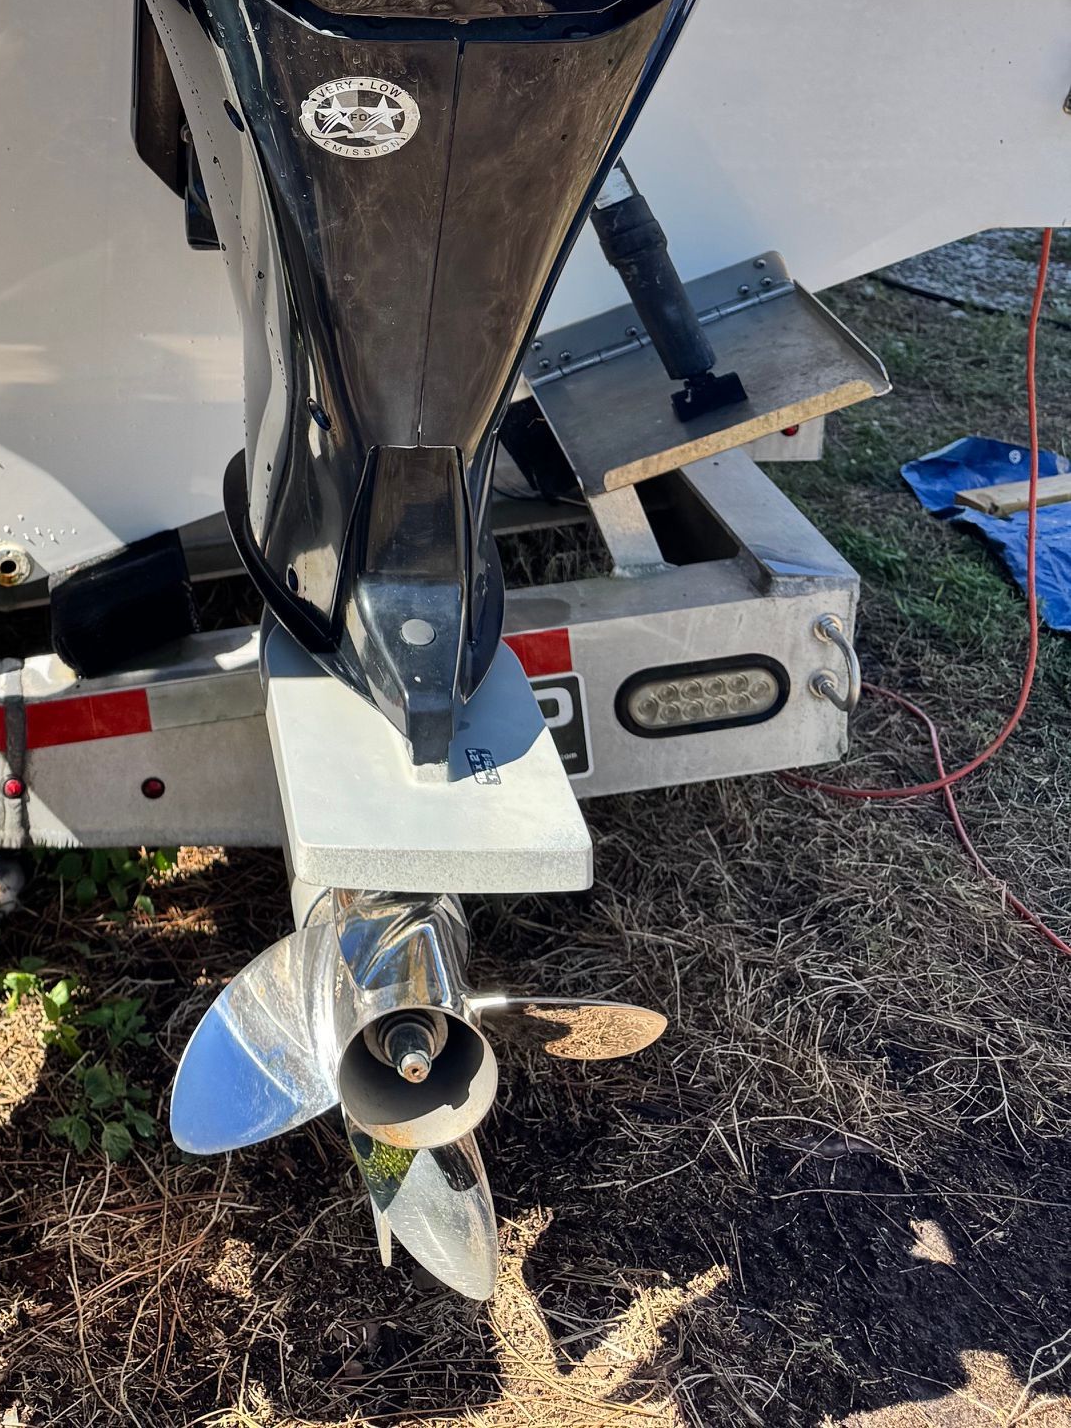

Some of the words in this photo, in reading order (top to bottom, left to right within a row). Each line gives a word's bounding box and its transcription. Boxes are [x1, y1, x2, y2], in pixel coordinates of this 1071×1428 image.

[317, 80, 352, 98] VERY
[370, 81, 403, 98] LOW
[323, 140, 400, 156] EMISSION
